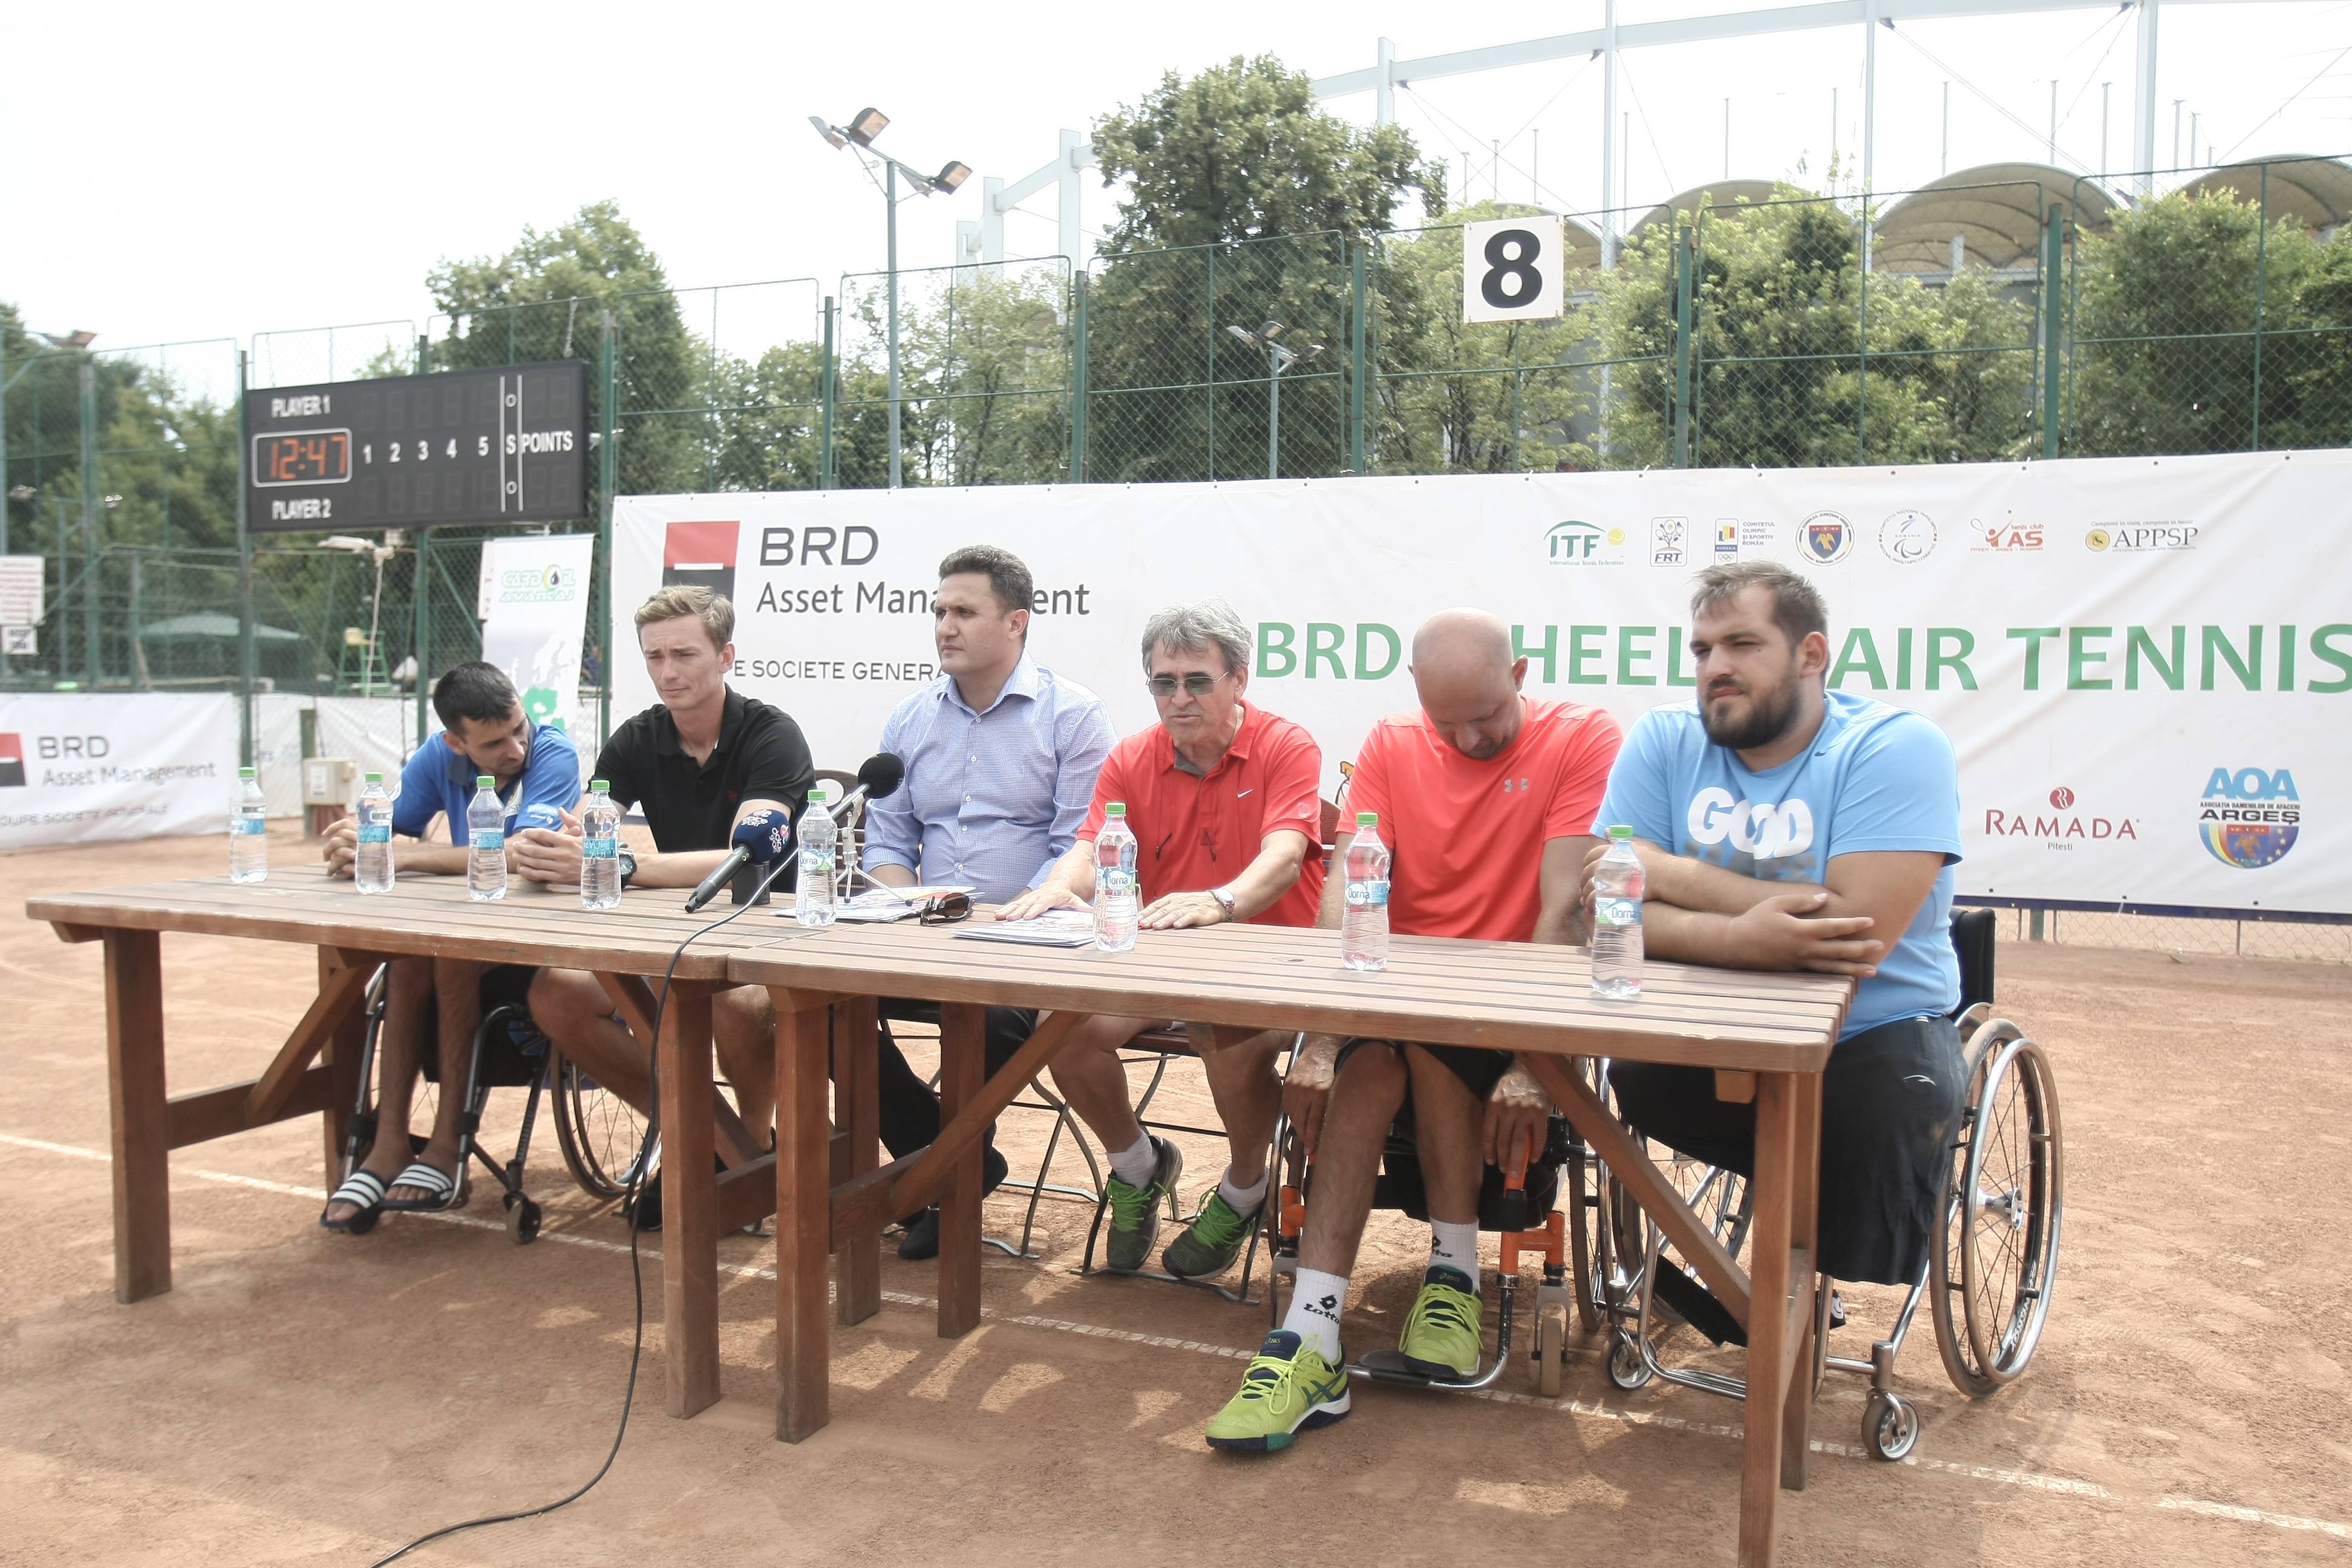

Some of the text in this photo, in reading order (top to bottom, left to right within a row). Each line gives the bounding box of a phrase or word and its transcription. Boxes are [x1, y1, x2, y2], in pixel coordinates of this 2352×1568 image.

[1481, 229, 1543, 309] 8
[271, 394, 330, 418] PLAYER 1
[270, 434, 347, 480] 12:47
[364, 431, 573, 463] 1 2 3 4 5 S POINTS
[272, 500, 331, 521] PLAYER 2
[759, 526, 879, 566] BRD
[1550, 535, 1600, 558] ITF
[2113, 527, 2198, 547] APPSP
[1655, 553, 1682, 562] FRT
[756, 581, 844, 613] Asset
[1256, 622, 2352, 694] BRD HEELAIR TENNIS
[753, 661, 845, 679] SOCIETE
[39, 736, 109, 759] BRD
[41, 763, 217, 785] Asset Management
[2202, 768, 2300, 801] AOA
[1985, 809, 2137, 840] RAMADA
[2200, 809, 2300, 826] ARGEȘ
[1304, 1303, 1340, 1324] Lotto
